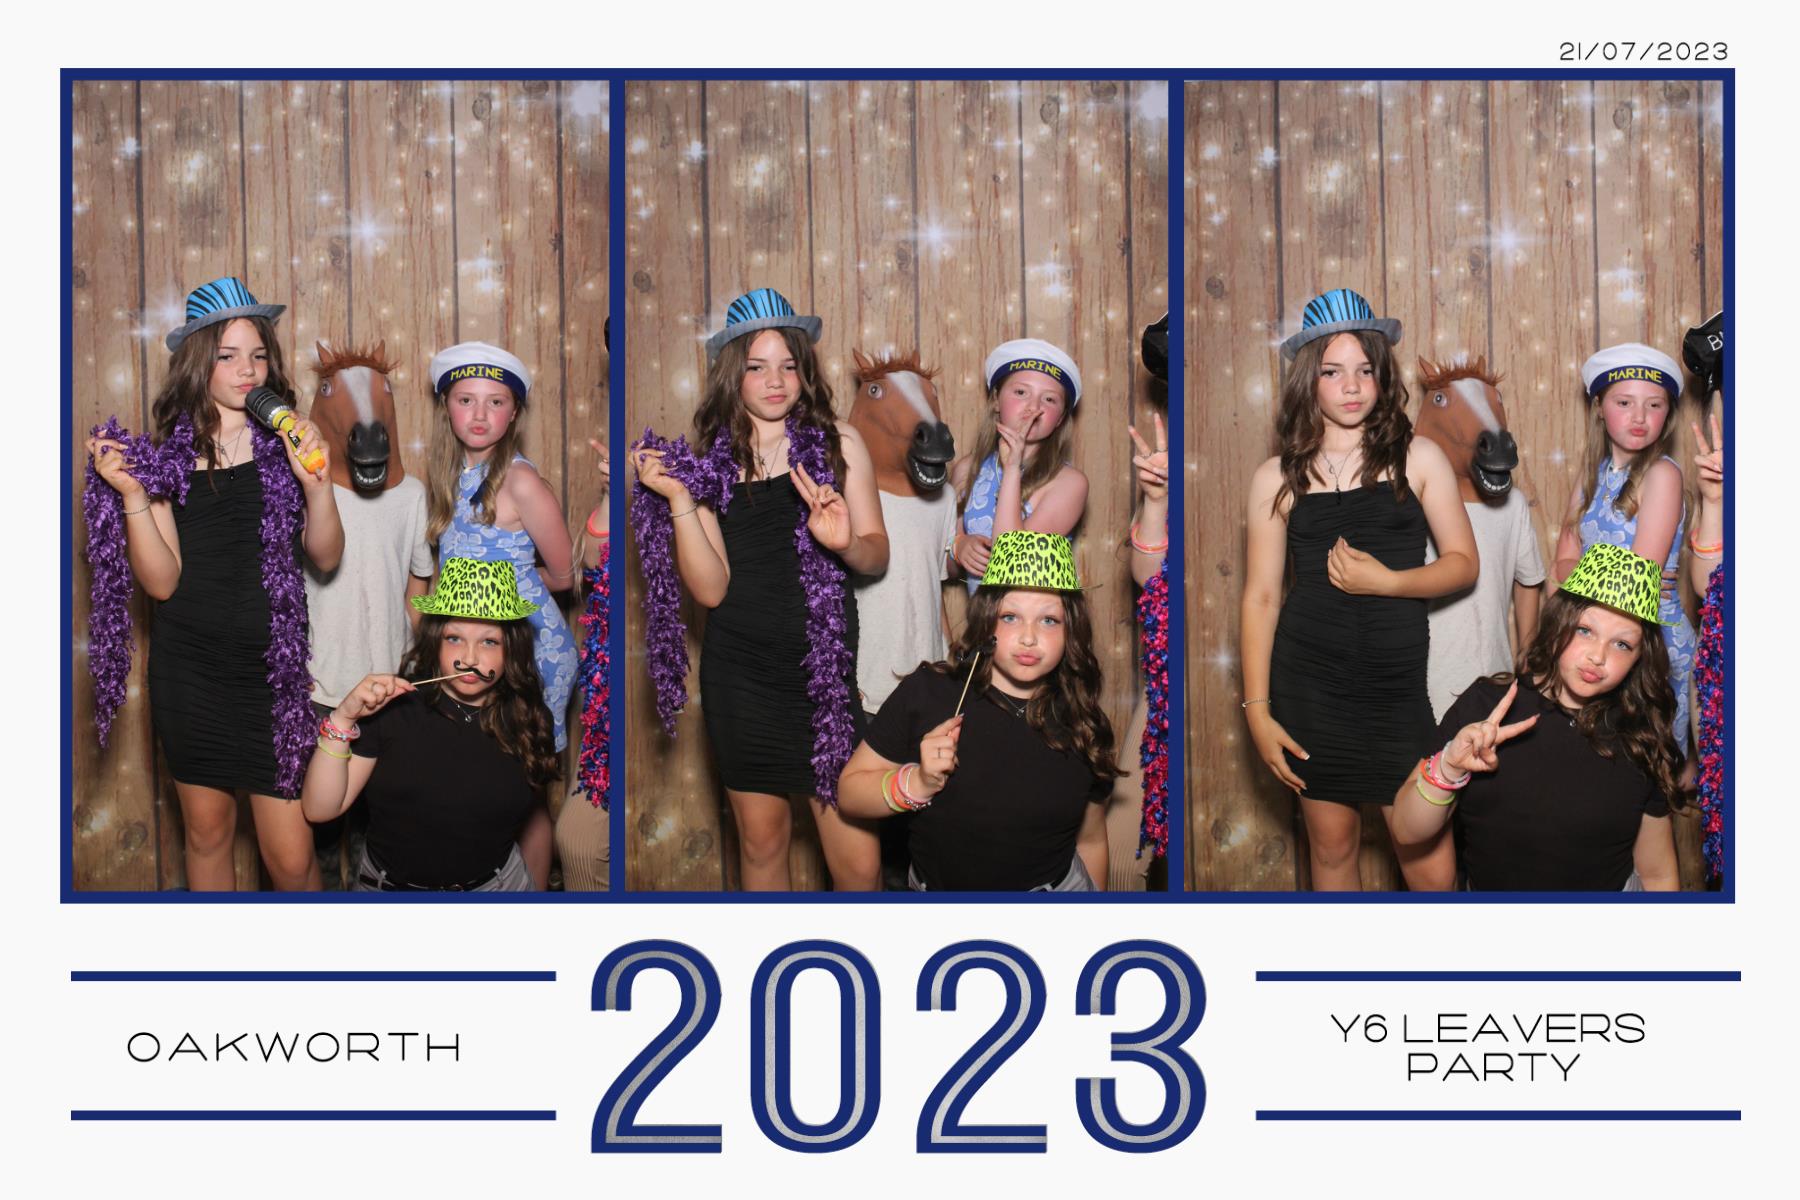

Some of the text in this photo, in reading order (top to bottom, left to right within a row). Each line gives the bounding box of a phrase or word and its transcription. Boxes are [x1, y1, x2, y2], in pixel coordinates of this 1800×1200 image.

[450, 365, 504, 381] MARINE
[1009, 359, 1062, 381] MARINE
[1608, 367, 1663, 383] MARINE
